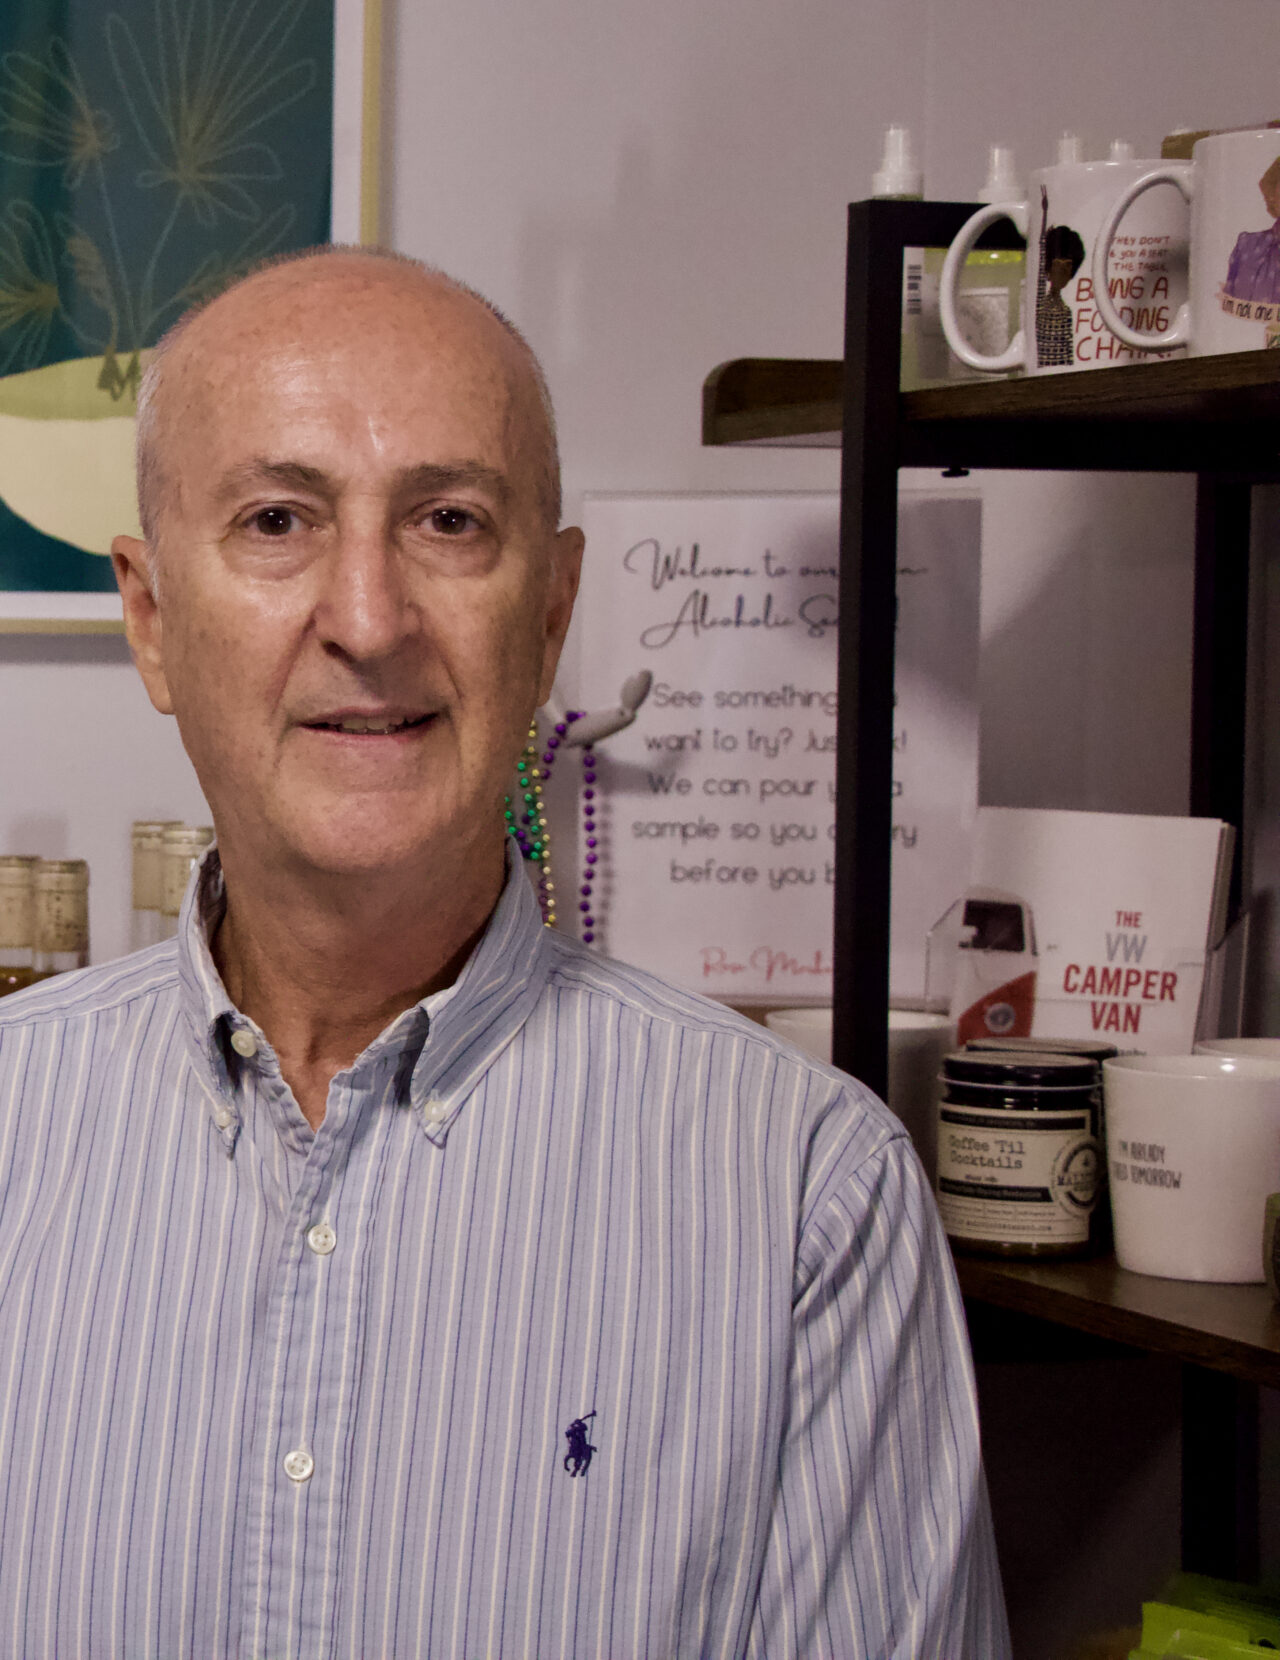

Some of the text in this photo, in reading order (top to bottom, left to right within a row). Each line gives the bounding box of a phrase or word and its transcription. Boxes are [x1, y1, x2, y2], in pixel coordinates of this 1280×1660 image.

[1151, 276, 1169, 300] A
[1075, 306, 1170, 334] FODING
[623, 537, 758, 591] Welcome
[761, 548, 793, 578] to
[639, 588, 795, 650] Alcoholic
[653, 682, 838, 718] See something
[645, 726, 837, 759] want to try? Jus
[647, 771, 692, 796] We
[702, 778, 751, 796] can
[760, 777, 820, 805] pour
[631, 815, 721, 847] sample
[730, 821, 761, 841] so
[769, 821, 819, 847] you
[670, 858, 759, 884] before
[768, 865, 816, 891] you
[1115, 910, 1143, 928] THE
[1105, 932, 1148, 963] VW
[1063, 963, 1178, 1003] CAMPER
[1090, 1001, 1142, 1035] VAN
[950, 1150, 1024, 1169] Cocktails
